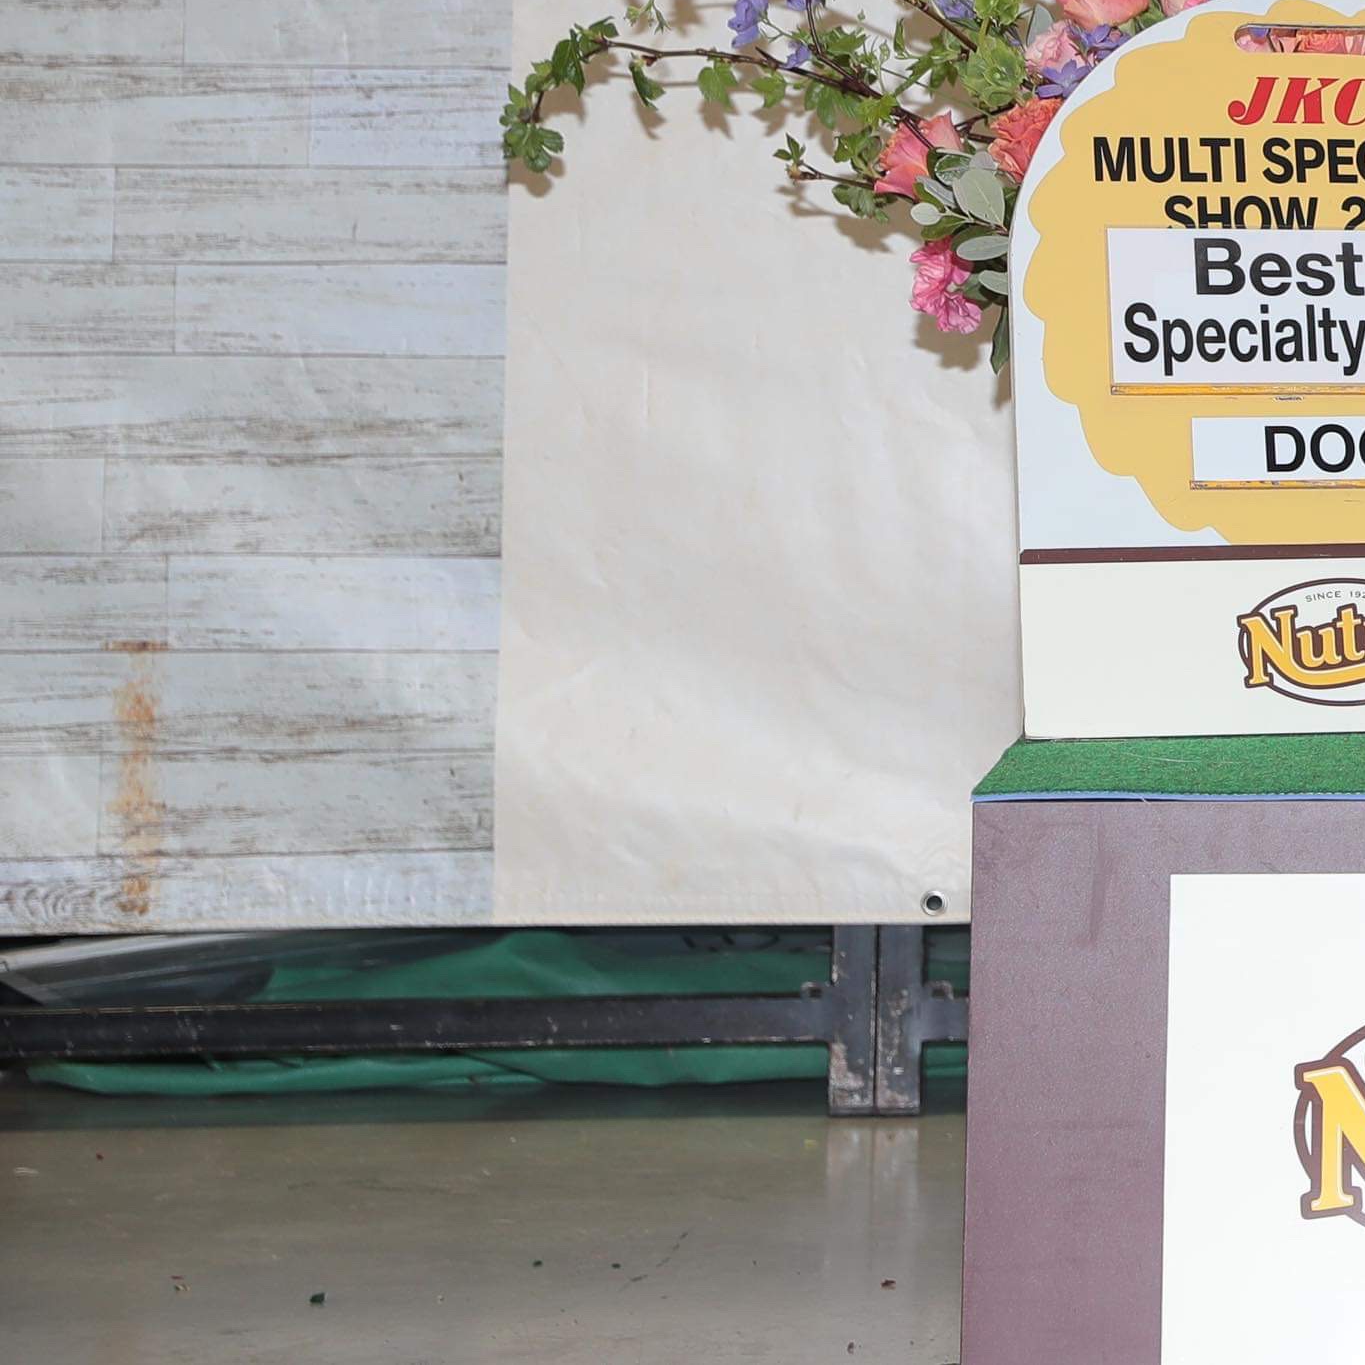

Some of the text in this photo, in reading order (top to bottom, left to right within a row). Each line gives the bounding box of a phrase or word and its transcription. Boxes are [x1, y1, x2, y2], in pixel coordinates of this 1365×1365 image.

[1093, 137, 1247, 184] MULTI
[1164, 195, 1319, 229] SHOW
[1193, 238, 1365, 297] Best
[1305, 590, 1341, 603] SINCE
